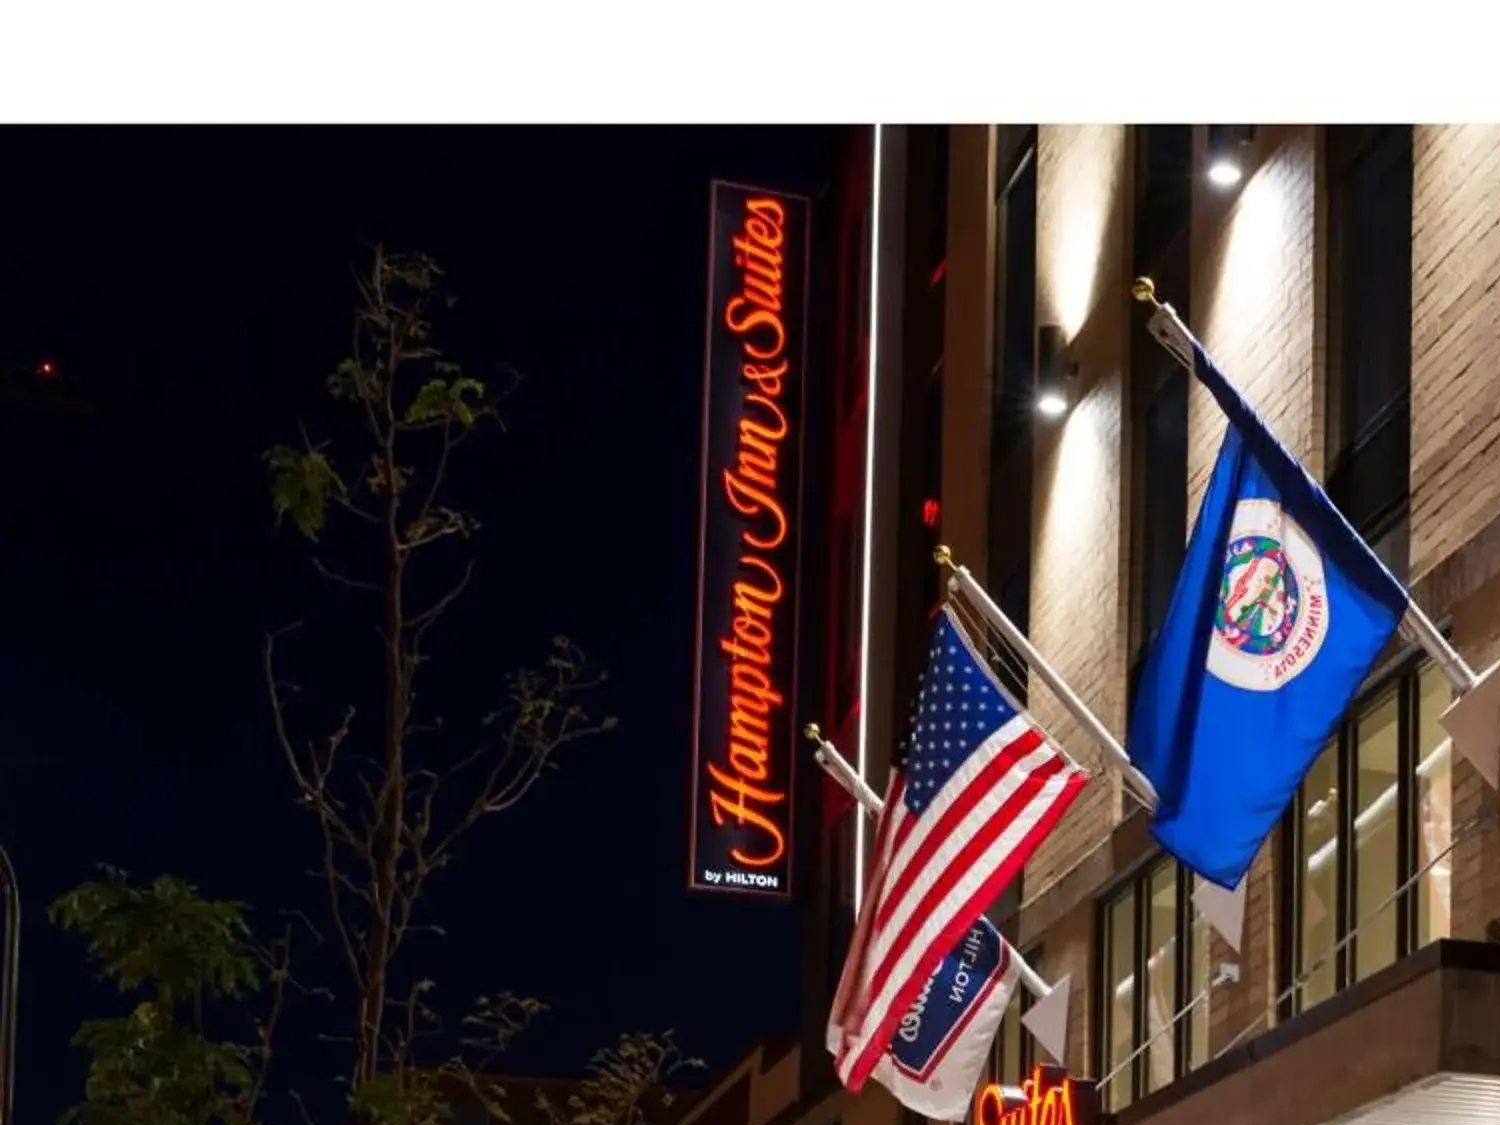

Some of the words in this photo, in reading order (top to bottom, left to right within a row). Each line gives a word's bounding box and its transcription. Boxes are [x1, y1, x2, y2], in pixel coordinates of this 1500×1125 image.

[725, 197, 787, 360] Suites
[742, 358, 788, 397] &
[723, 395, 789, 549] Inn
[707, 556, 786, 866] Hampton
[705, 869, 721, 883] by
[725, 871, 778, 887] HILTON
